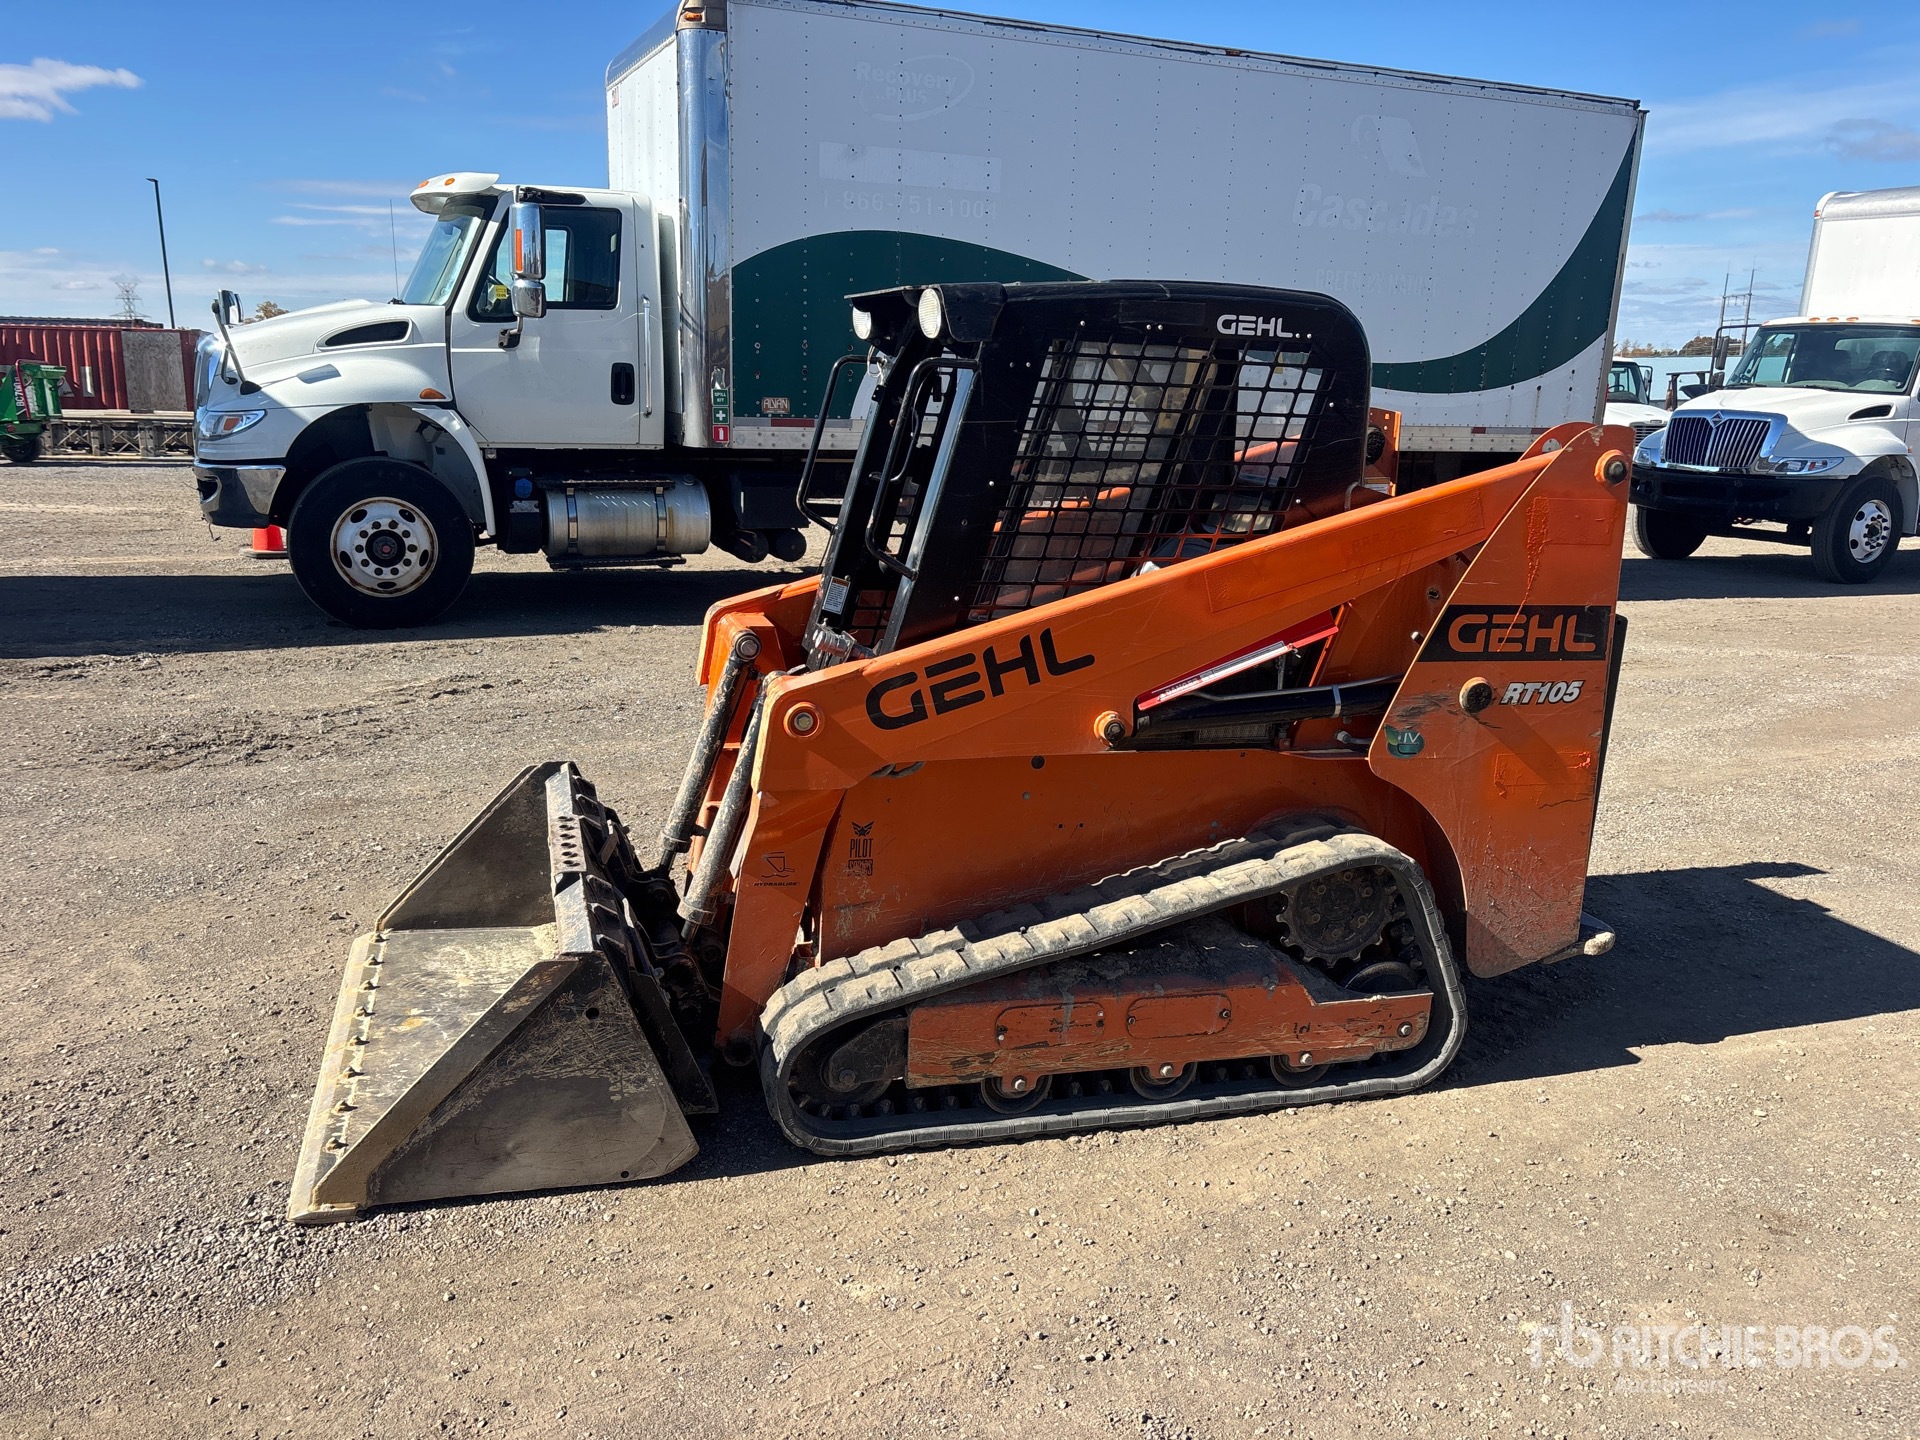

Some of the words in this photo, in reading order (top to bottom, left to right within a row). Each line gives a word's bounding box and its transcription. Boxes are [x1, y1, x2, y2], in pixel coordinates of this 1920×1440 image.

[856, 61, 957, 95] Recovery
[824, 189, 998, 220] 1-866-751-1004
[1292, 183, 1480, 239] Cascades
[1216, 314, 1293, 338] GEHL
[763, 398, 788, 409] ALVAN
[1448, 614, 1597, 653] GEHL
[865, 627, 1096, 731] GEHL
[1499, 680, 1586, 706] RT105
[850, 838, 874, 858] PILOT
